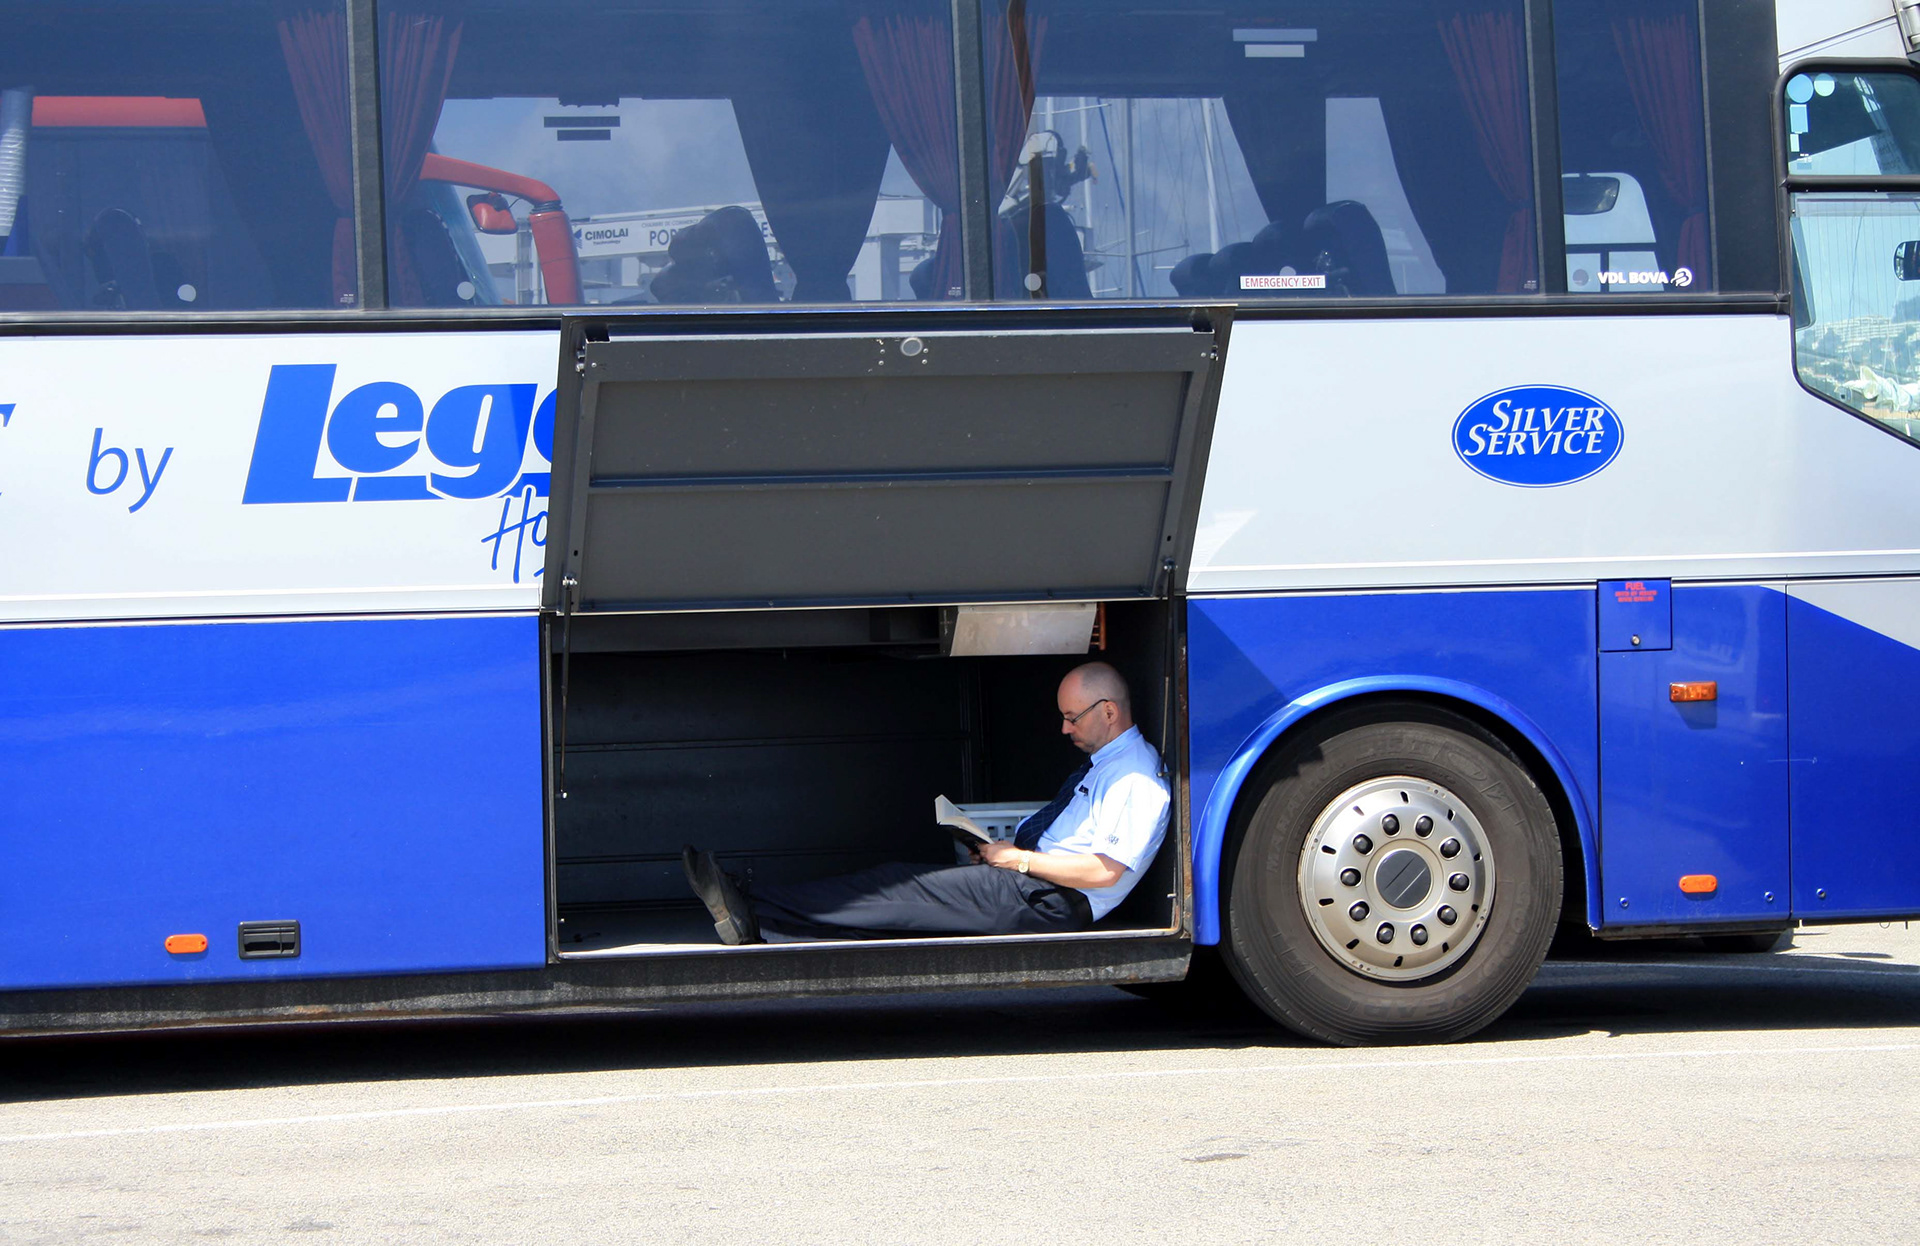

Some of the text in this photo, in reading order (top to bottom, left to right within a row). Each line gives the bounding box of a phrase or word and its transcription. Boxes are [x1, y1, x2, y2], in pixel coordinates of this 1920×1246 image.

[585, 228, 629, 241] CIMOLAI
[1245, 277, 1321, 288] EMERGENCY EXIT
[1598, 271, 1669, 285] VDL BOVA
[242, 363, 558, 505] Leg
[1463, 399, 1605, 457] SILVER SERVICE
[86, 427, 174, 514] by
[481, 487, 549, 584] Ho
